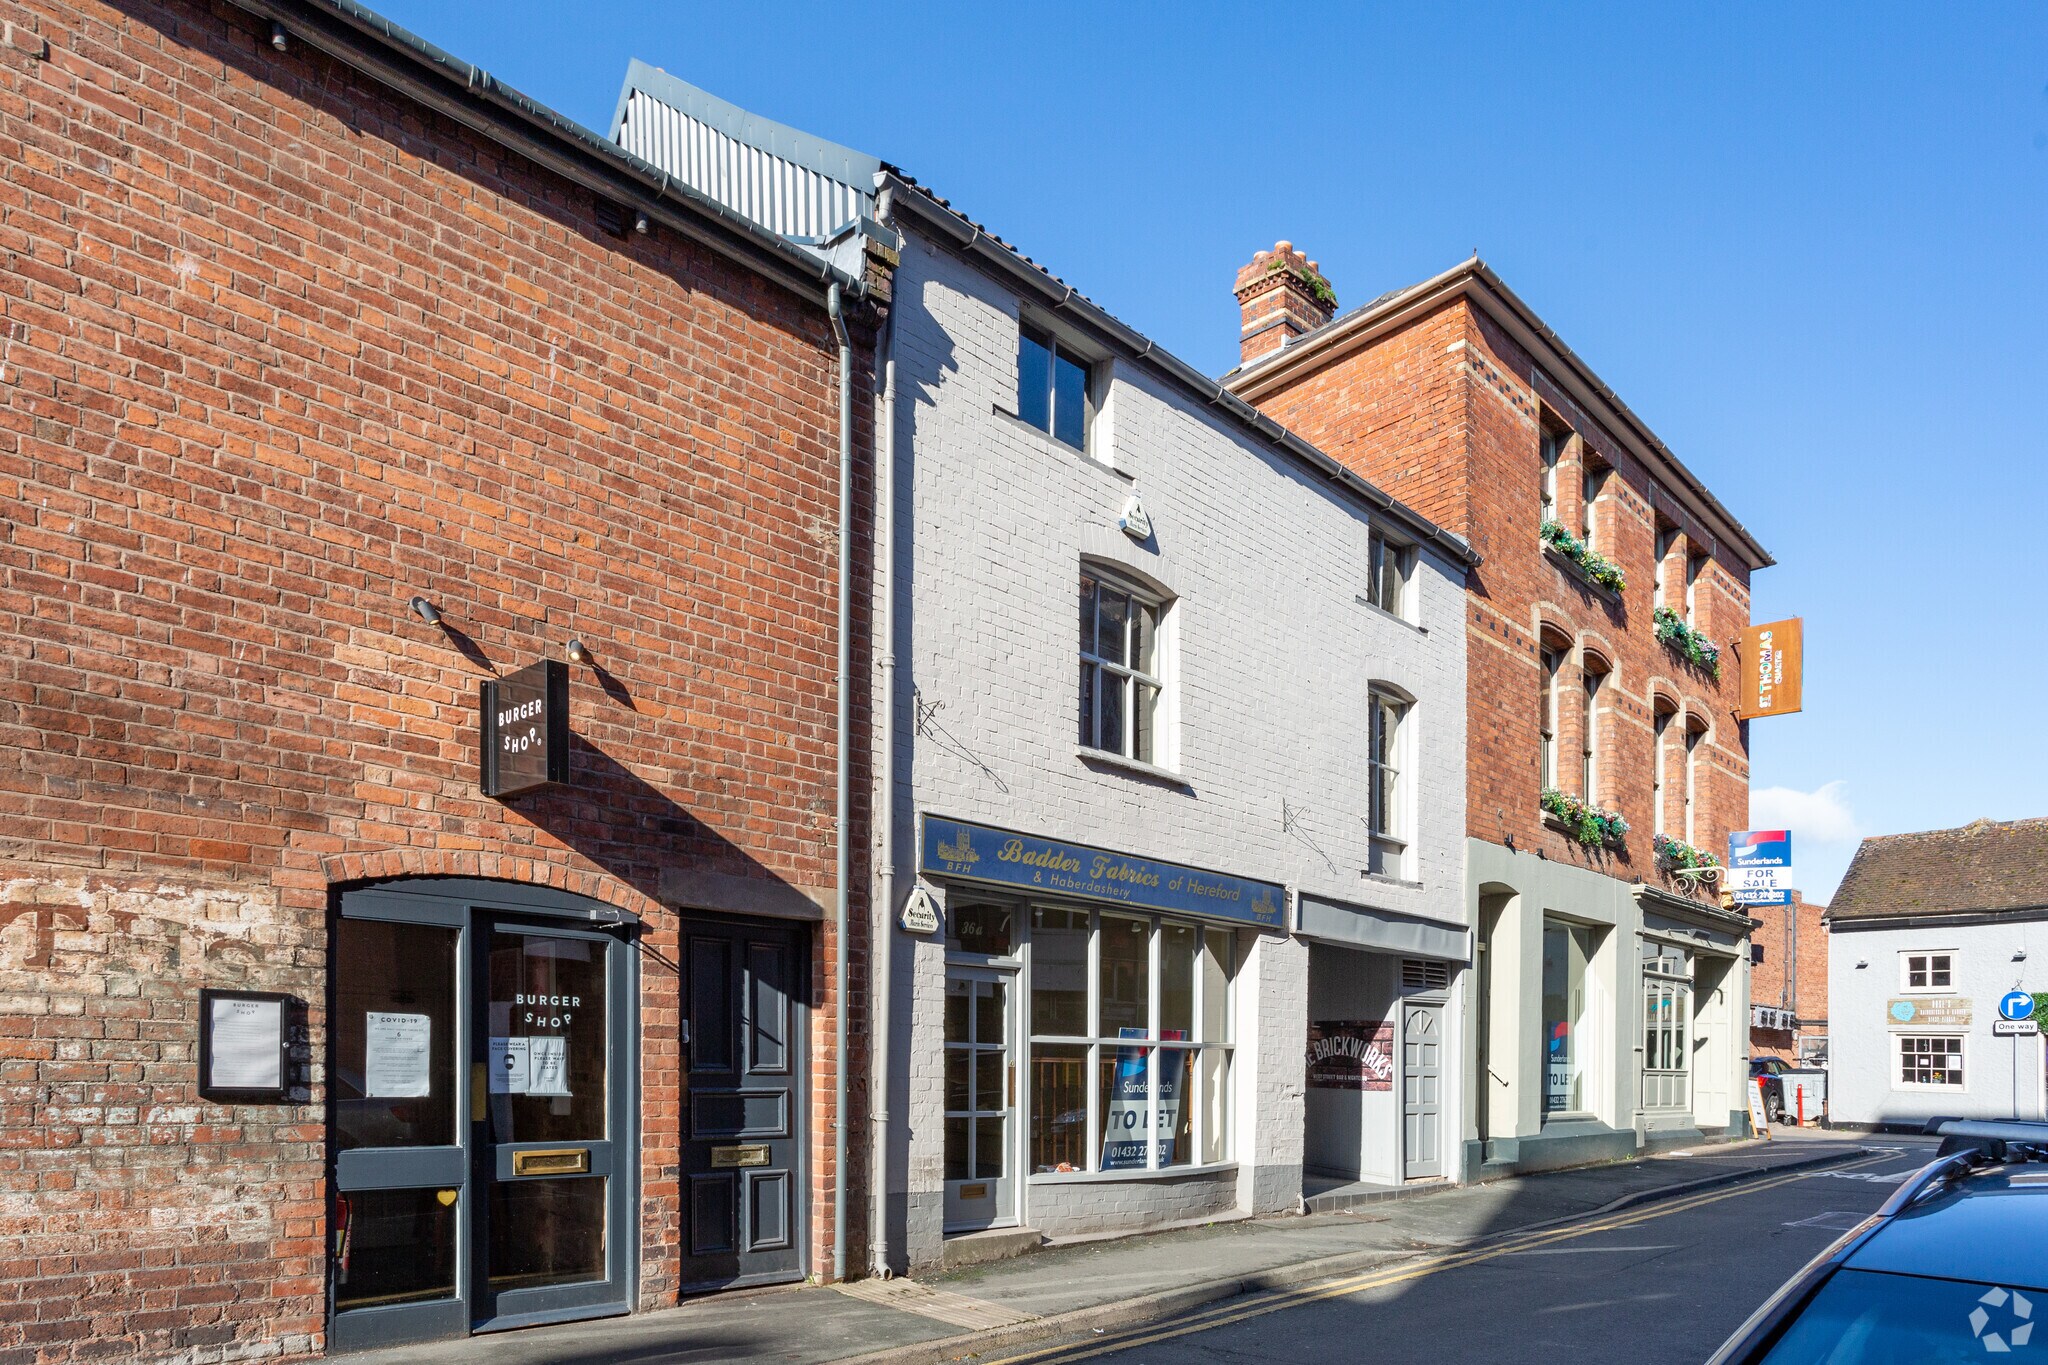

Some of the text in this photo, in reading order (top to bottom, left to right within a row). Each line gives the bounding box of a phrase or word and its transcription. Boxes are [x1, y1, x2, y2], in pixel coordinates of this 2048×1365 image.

[1759, 631, 1772, 694] THOMAS
[1774, 650, 1782, 684] QUARTER
[498, 699, 542, 726] BURGER
[504, 727, 536, 753] SHOP
[946, 862, 971, 873] BFH
[1737, 857, 1783, 865] Sunderlands
[998, 839, 1240, 901] Badder Fabrics of Hereford
[1747, 869, 1774, 878] FOR
[1034, 870, 1131, 899] & Haberdashery
[1743, 879, 1778, 888] SALE
[907, 908, 935, 922] Security
[961, 921, 984, 935] 36a
[516, 994, 580, 1007] BURGER
[525, 1012, 571, 1027] SHOP
[1313, 1035, 1393, 1080] BRICKWORKS
[1548, 1073, 1558, 1086] TO
[1123, 1081, 1172, 1093] Sundends
[1111, 1110, 1137, 1129] TO
[1111, 1145, 1166, 1158] 01432 2702
